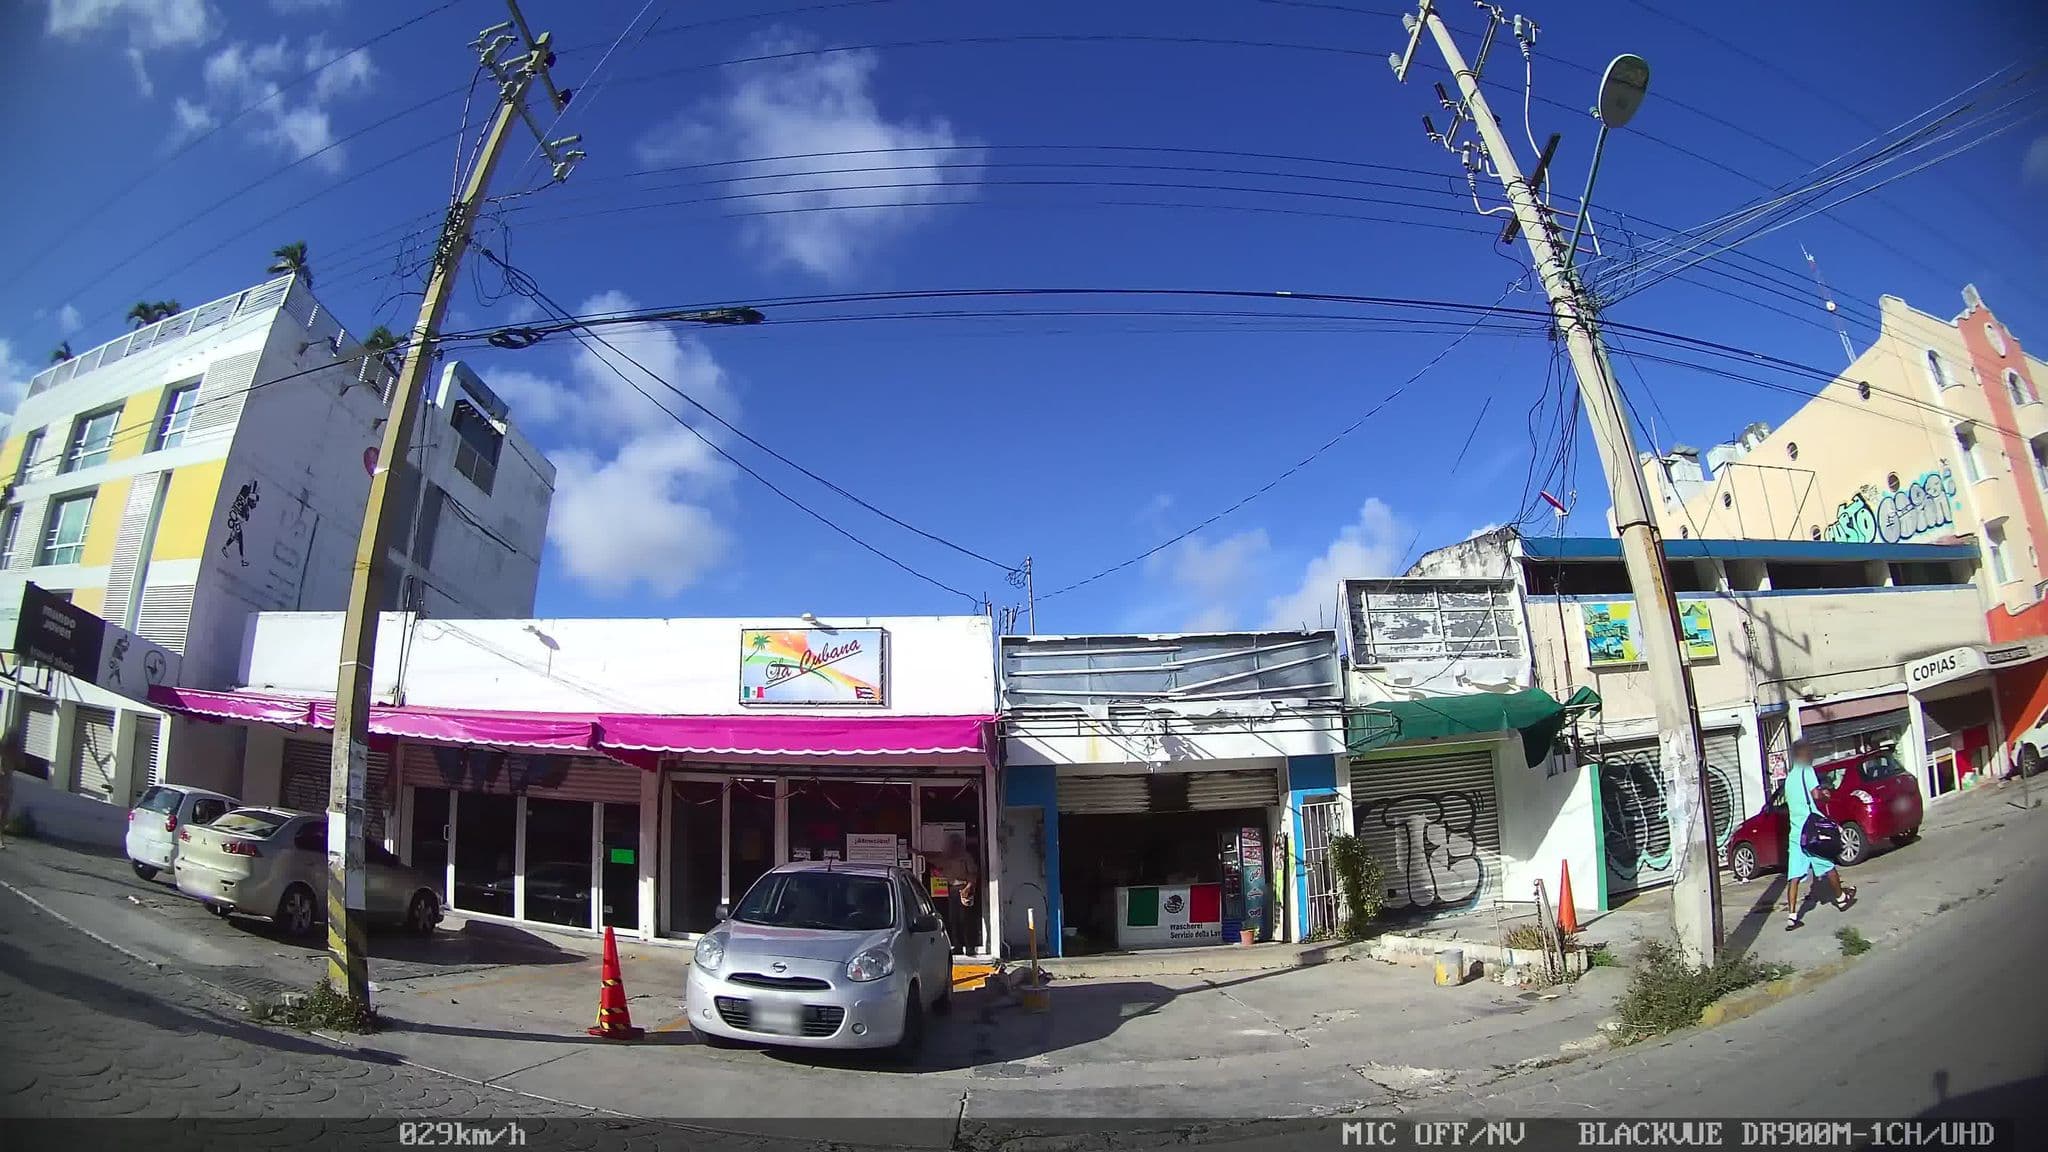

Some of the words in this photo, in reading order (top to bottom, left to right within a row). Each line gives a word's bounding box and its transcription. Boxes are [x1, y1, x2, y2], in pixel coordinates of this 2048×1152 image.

[800, 639, 861, 675] Cubana
[1913, 655, 1956, 681] COPIAS
[1170, 930, 1194, 939] Servizio
